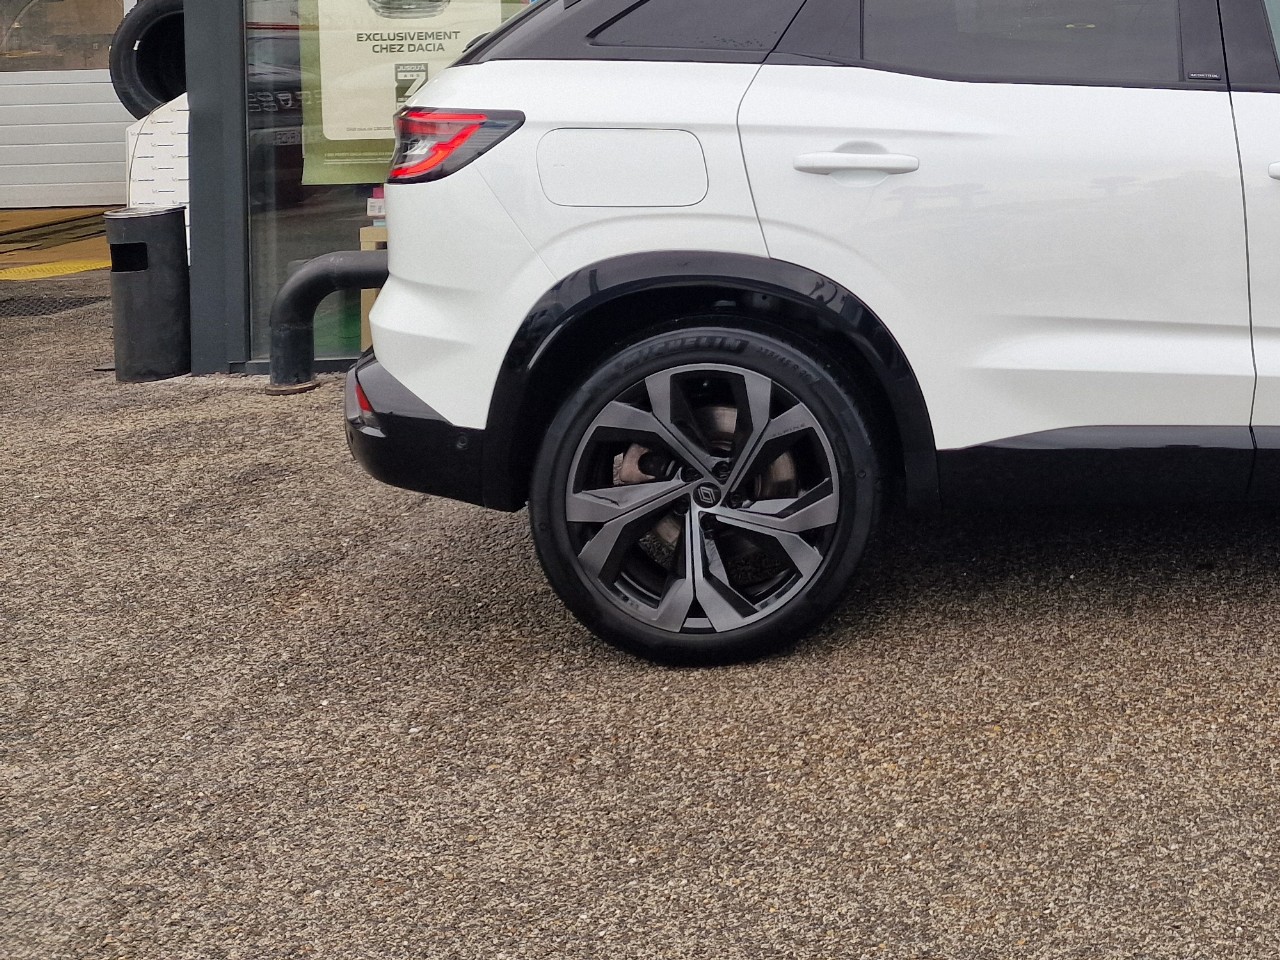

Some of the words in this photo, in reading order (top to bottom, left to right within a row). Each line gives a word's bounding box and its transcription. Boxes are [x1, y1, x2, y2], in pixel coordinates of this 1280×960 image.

[356, 30, 461, 43] EXCLUSIVEMENT
[372, 43, 405, 54] CHEZ
[407, 43, 445, 53] DACIA
